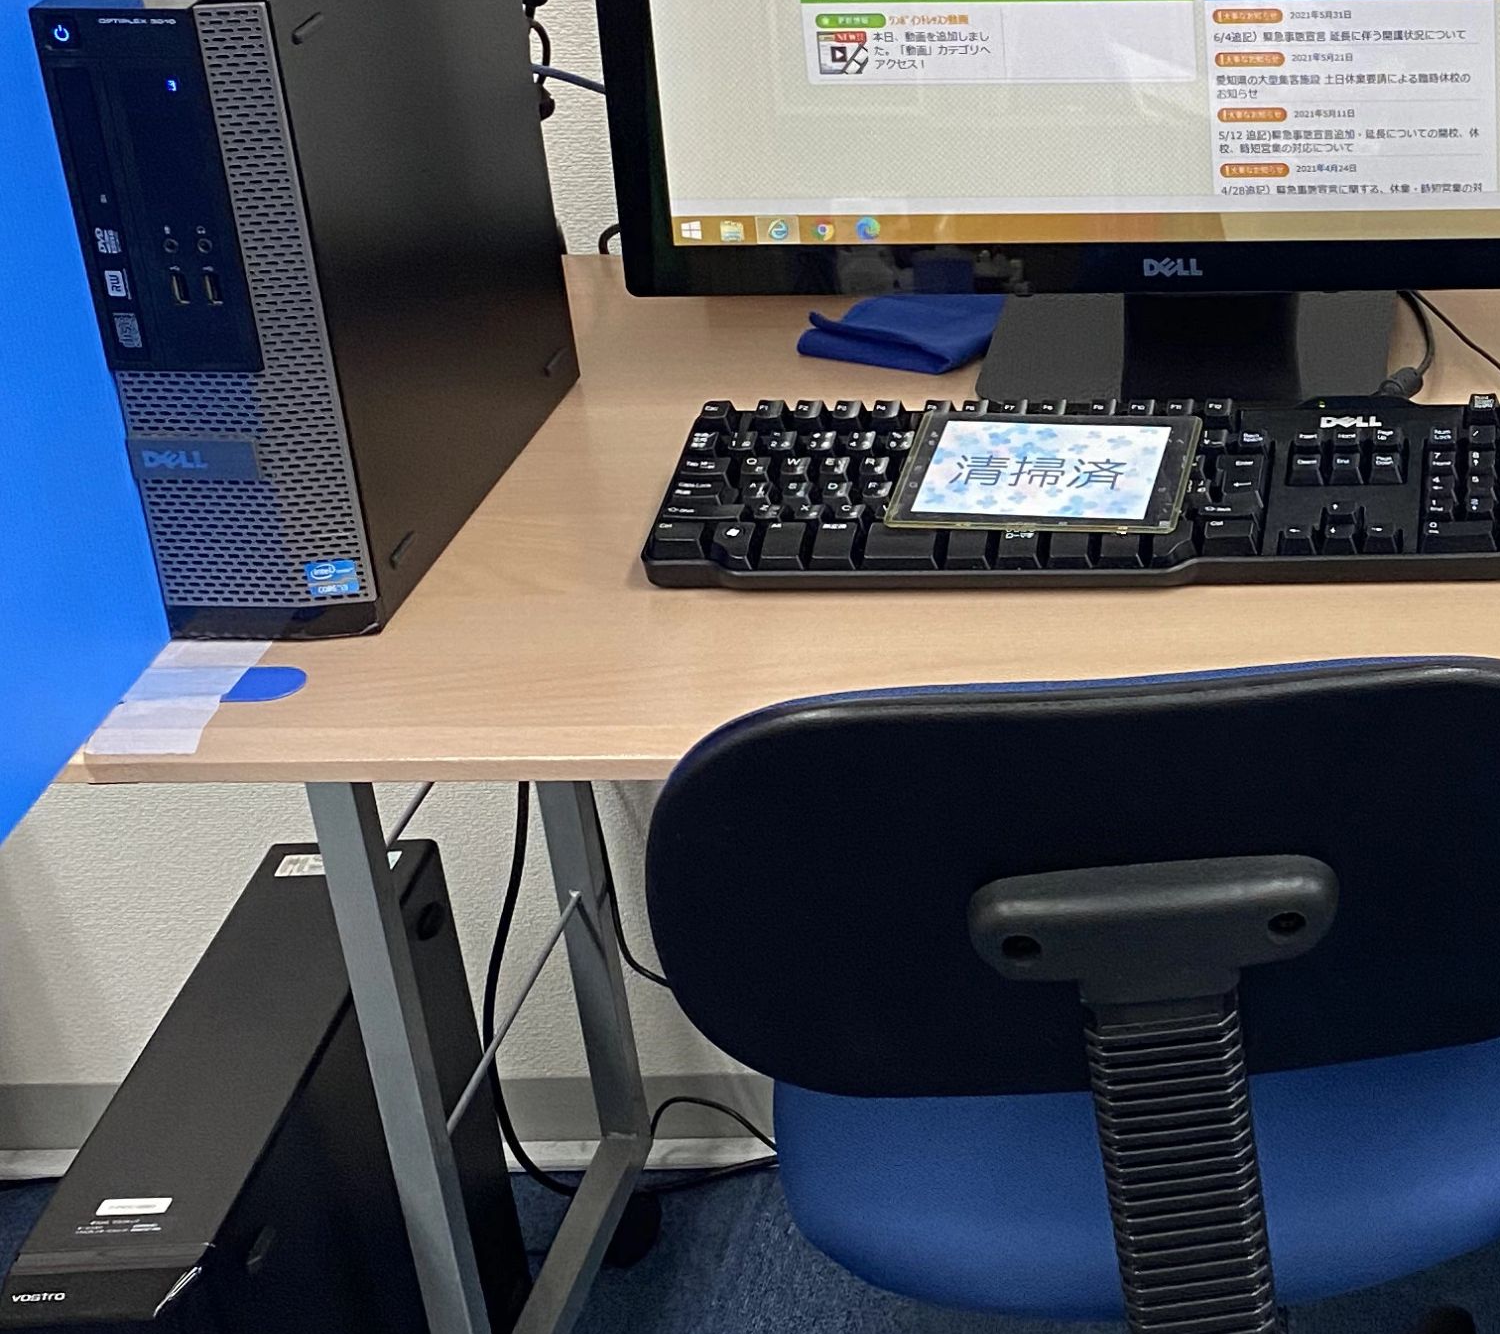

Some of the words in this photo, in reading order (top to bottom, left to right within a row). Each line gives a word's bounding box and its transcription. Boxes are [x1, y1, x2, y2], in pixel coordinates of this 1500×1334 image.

[1216, 88, 1258, 100] お知らせ
[1143, 257, 1203, 277] DELL
[1319, 416, 1382, 428] DELL
[142, 450, 209, 468] DELL
[949, 453, 1129, 491] 清掃済
[12, 1292, 66, 1303] vostro
